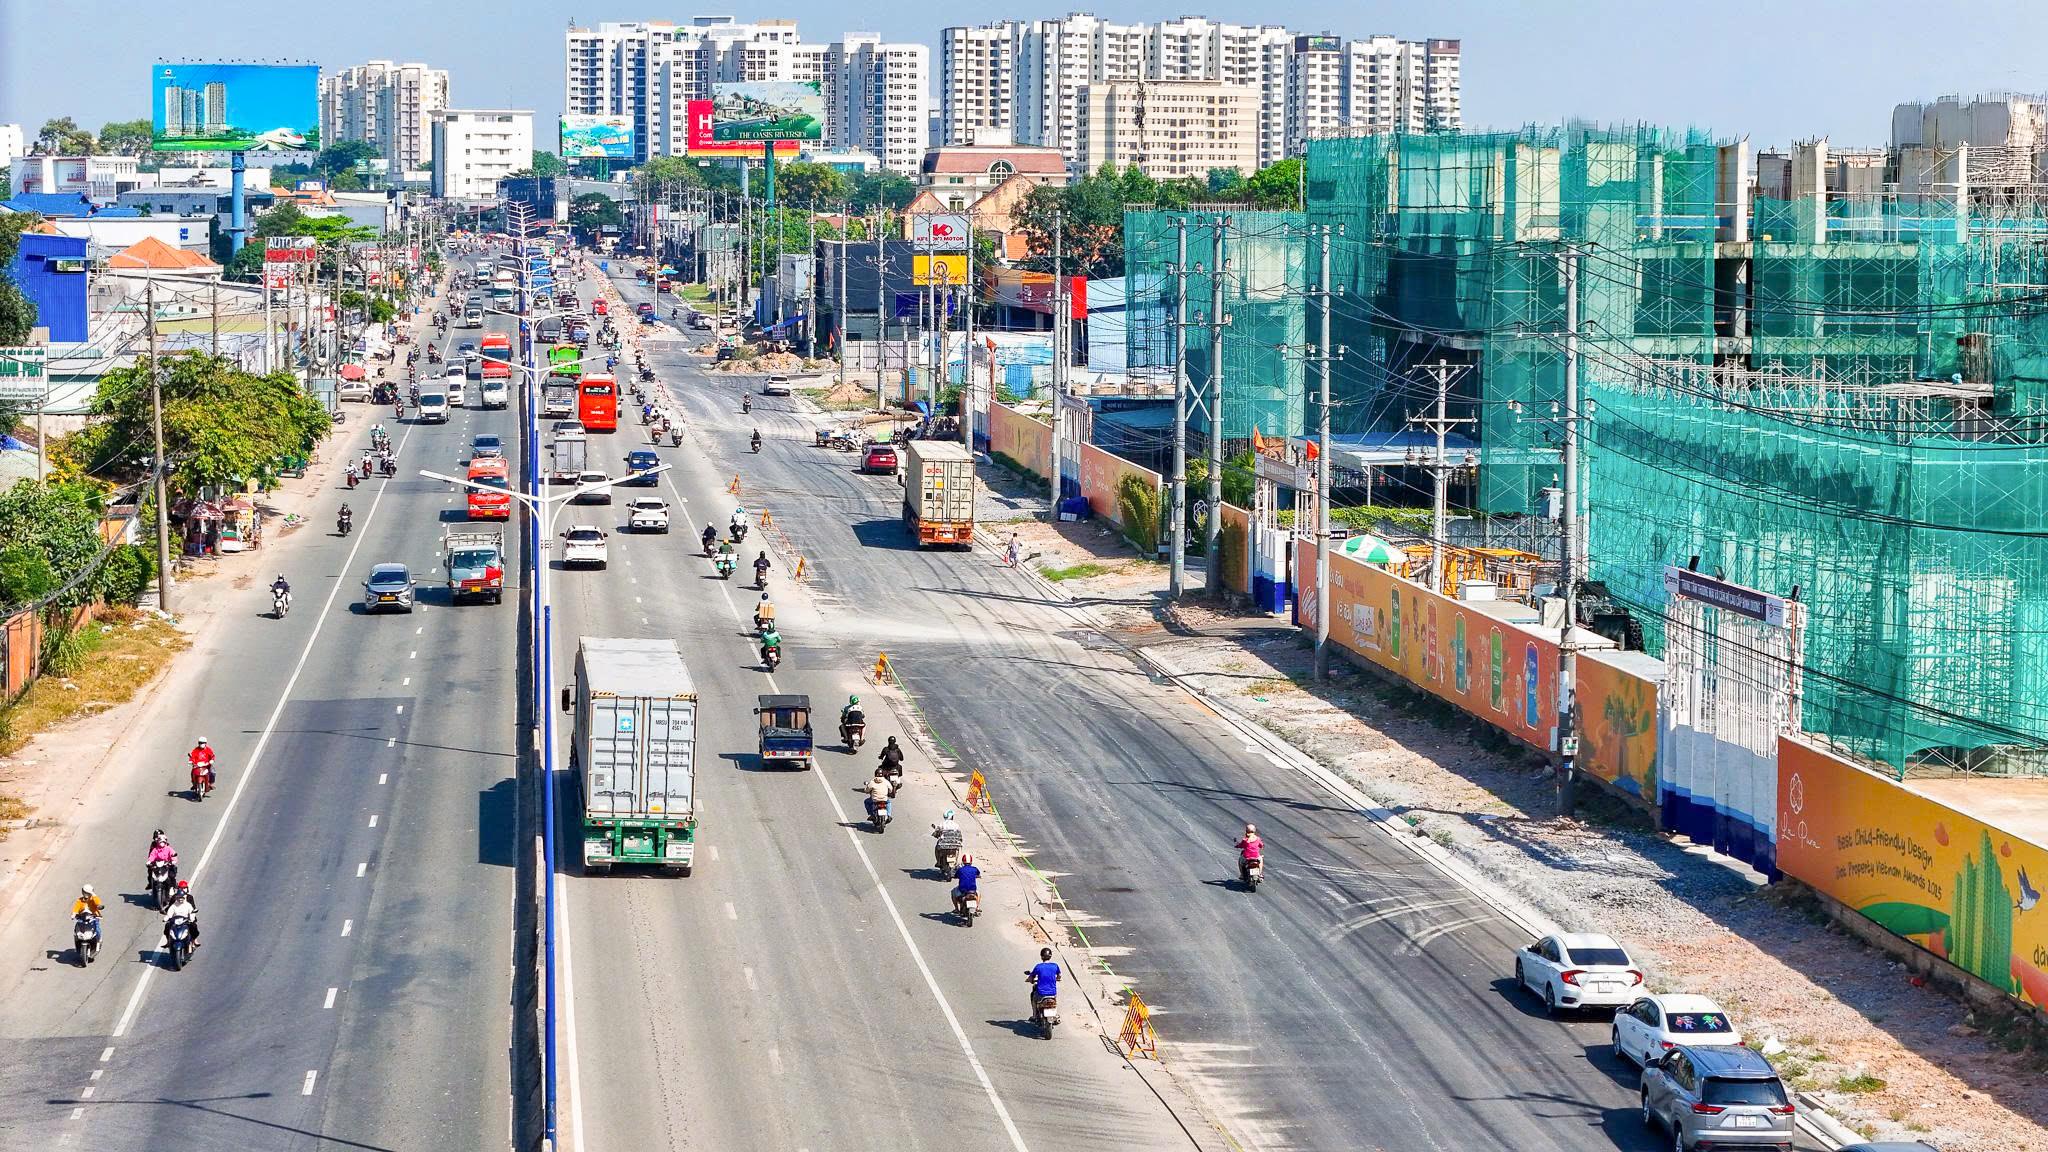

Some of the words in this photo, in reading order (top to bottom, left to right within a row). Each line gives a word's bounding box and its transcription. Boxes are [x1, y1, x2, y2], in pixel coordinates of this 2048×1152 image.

[739, 131, 751, 139] THE
[752, 131, 773, 139] OASIS
[269, 237, 292, 248] AUTO
[1836, 831, 1854, 851] Best
[1907, 836, 1934, 871] Design
[1847, 860, 1875, 878] Property
[1876, 860, 1902, 878] Vietnam
[1902, 866, 1926, 890] Awards
[1927, 879, 1943, 901] 2025
